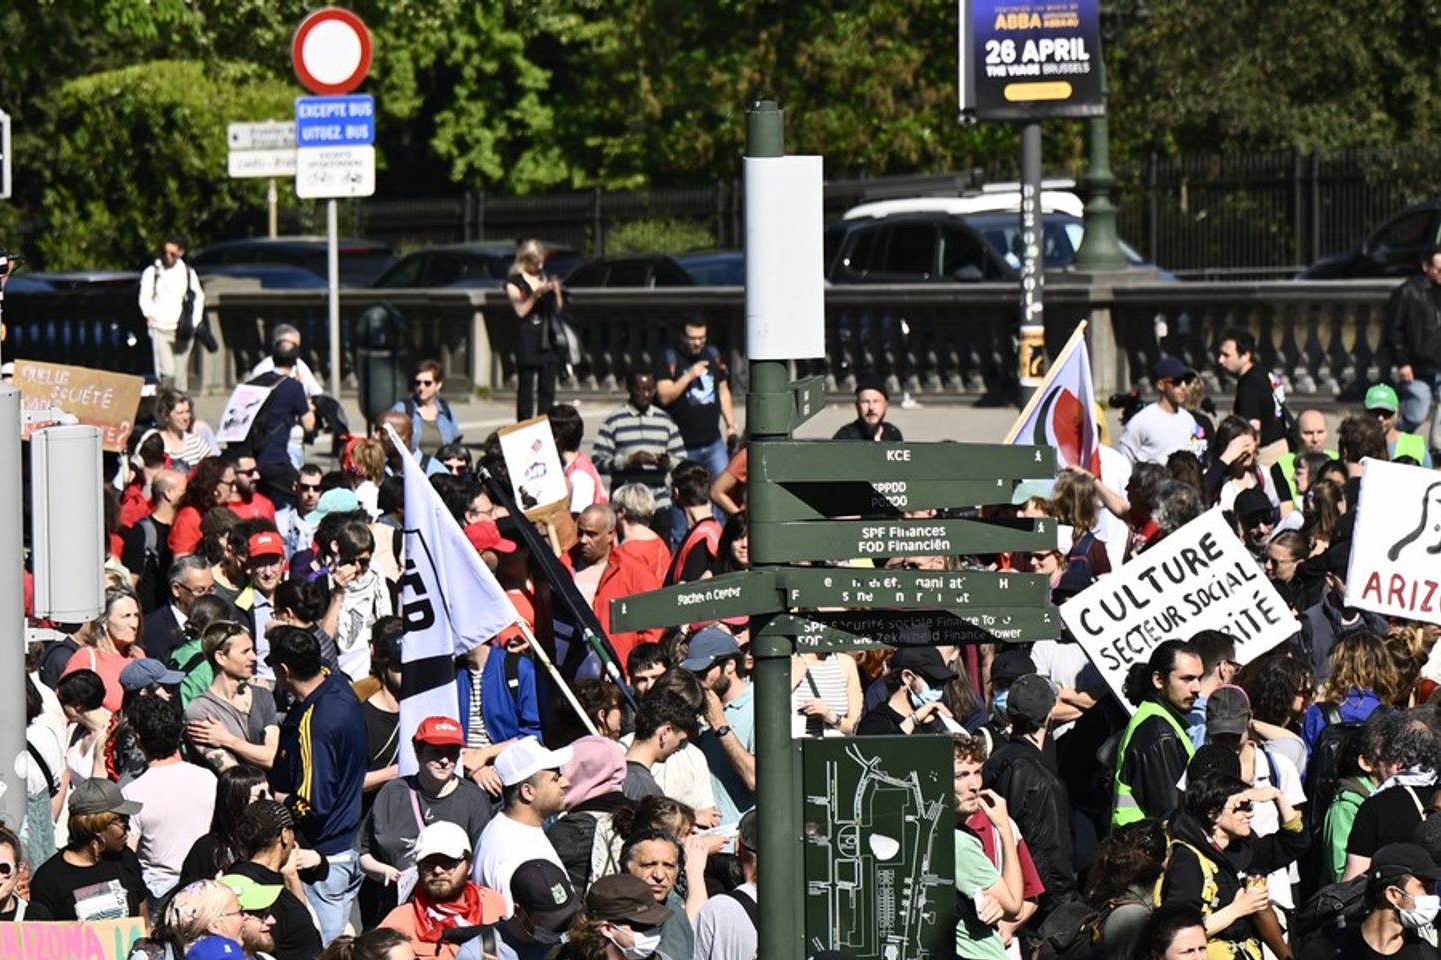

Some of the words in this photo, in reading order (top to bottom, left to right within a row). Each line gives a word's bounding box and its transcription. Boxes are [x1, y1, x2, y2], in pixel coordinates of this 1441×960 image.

[995, 13, 1042, 30] ABBA
[985, 39, 1017, 64] 26
[1022, 37, 1090, 62] APRIL
[348, 102, 372, 116] BUS
[345, 124, 369, 139] BUS
[887, 450, 911, 461] KCE
[862, 527, 885, 539] SPF
[859, 541, 885, 552] FOD
[888, 538, 950, 552] Financiën
[1079, 531, 1224, 636] CULTURE
[1362, 571, 1441, 612] ARIZ
[1099, 604, 1187, 671] SECTEUR
